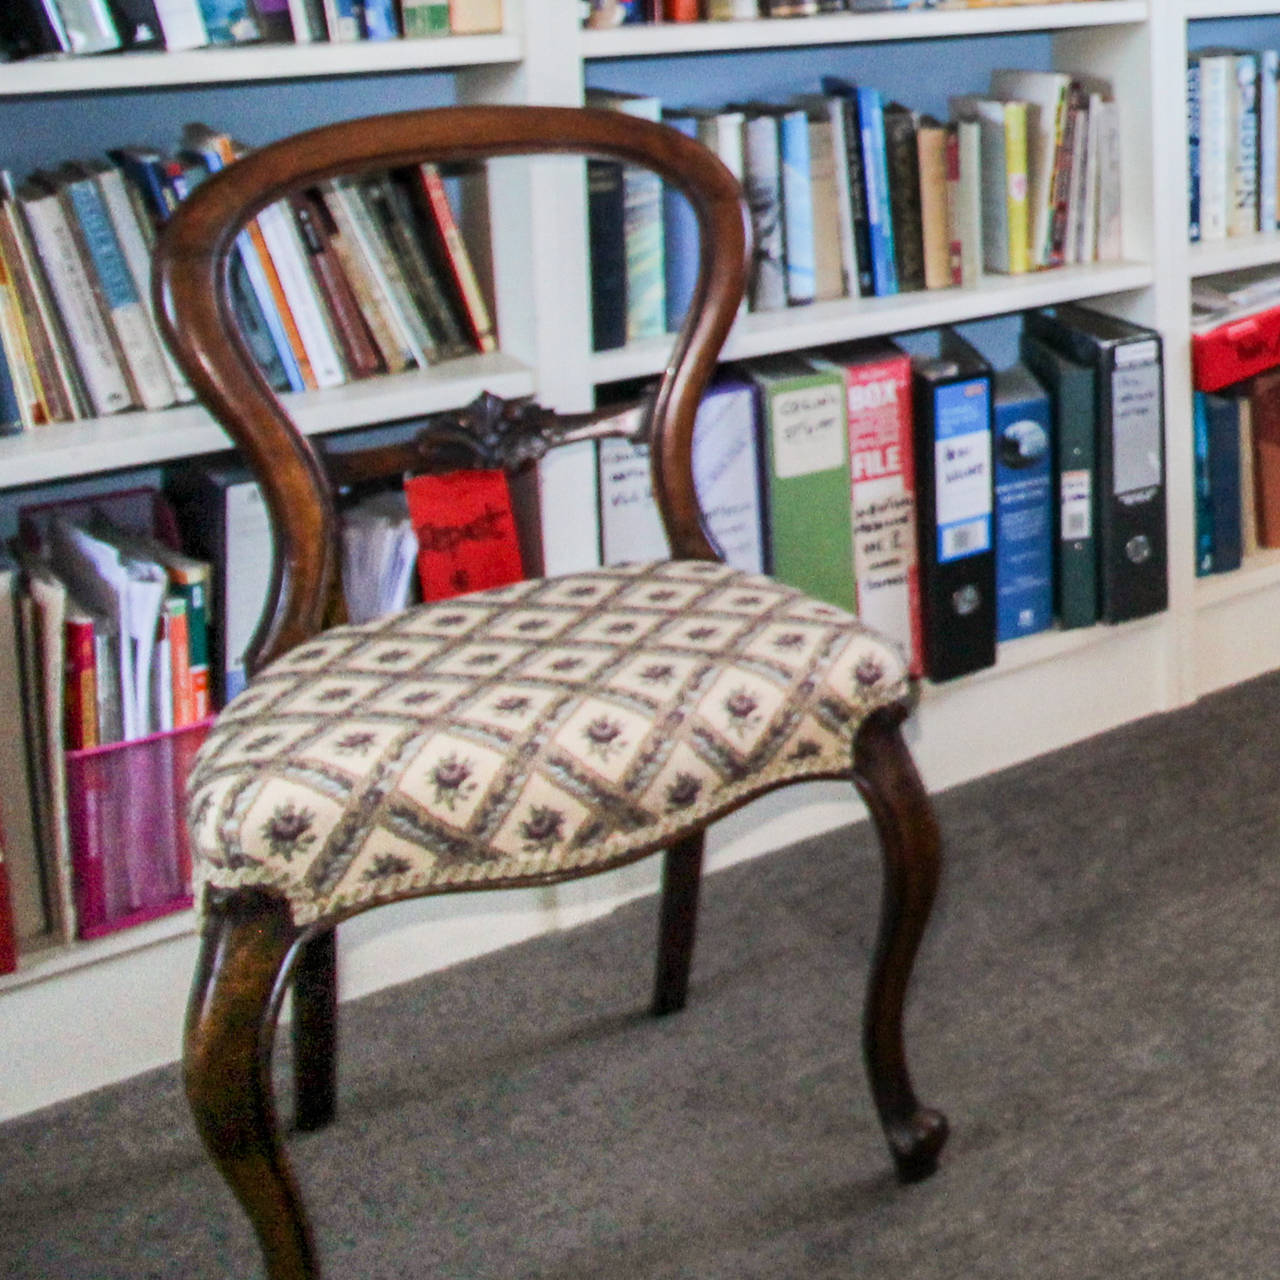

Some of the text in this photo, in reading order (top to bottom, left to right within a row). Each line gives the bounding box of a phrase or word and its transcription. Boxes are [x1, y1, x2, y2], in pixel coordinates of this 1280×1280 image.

[1236, 113, 1256, 210] Nelson
[848, 380, 897, 411] BOX
[852, 446, 903, 480] FILE
